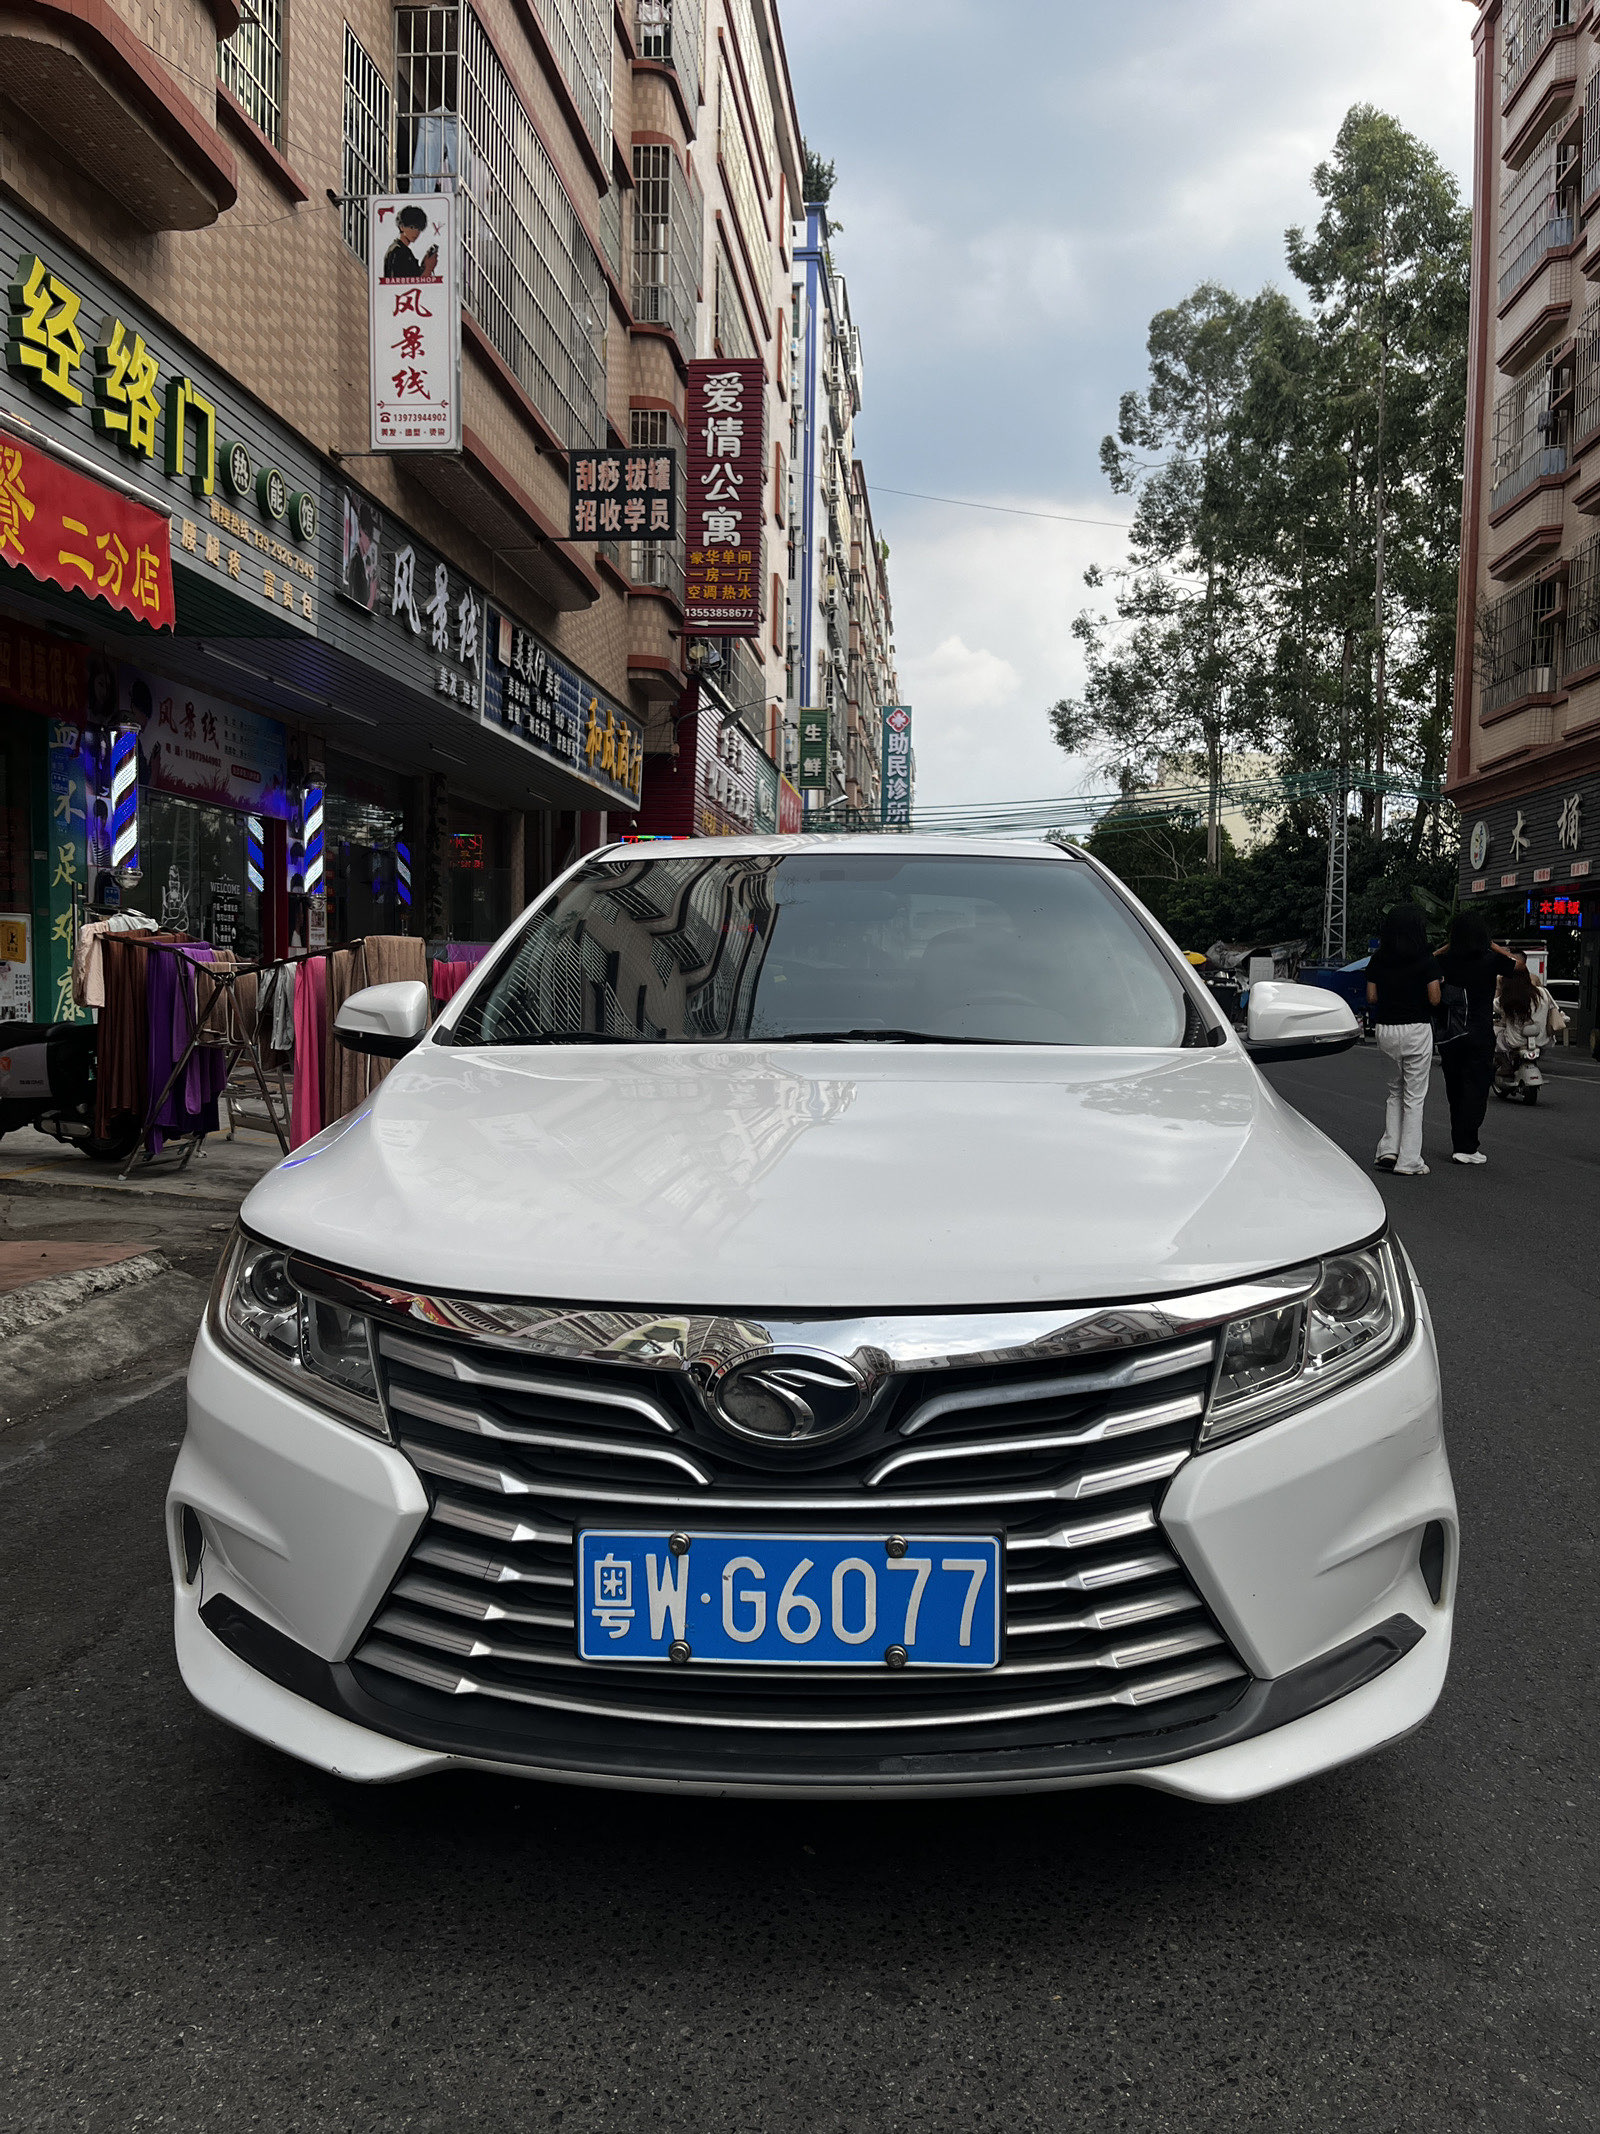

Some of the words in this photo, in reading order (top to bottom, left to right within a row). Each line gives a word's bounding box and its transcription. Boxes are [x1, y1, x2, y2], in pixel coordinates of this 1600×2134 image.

[385, 276, 437, 284] BARBERSHOP
[391, 288, 433, 400] 风景线
[8, 254, 216, 496] 经络门
[230, 446, 316, 538] 热能馆
[394, 413, 447, 422] 13973944902
[701, 371, 744, 547] 爱情公寓
[575, 498, 671, 533] 招收学员
[58, 515, 161, 613] 二分店
[689, 567, 752, 582] 一房一厅
[690, 549, 752, 565] 豪华单间
[391, 545, 481, 680] 风景线
[685, 608, 754, 618] 13553858677
[803, 724, 822, 777] 生鲜
[886, 732, 909, 823] 助民诊所
[210, 882, 240, 895] WELCOME
[591, 1553, 987, 1647] 粤W·G6077
